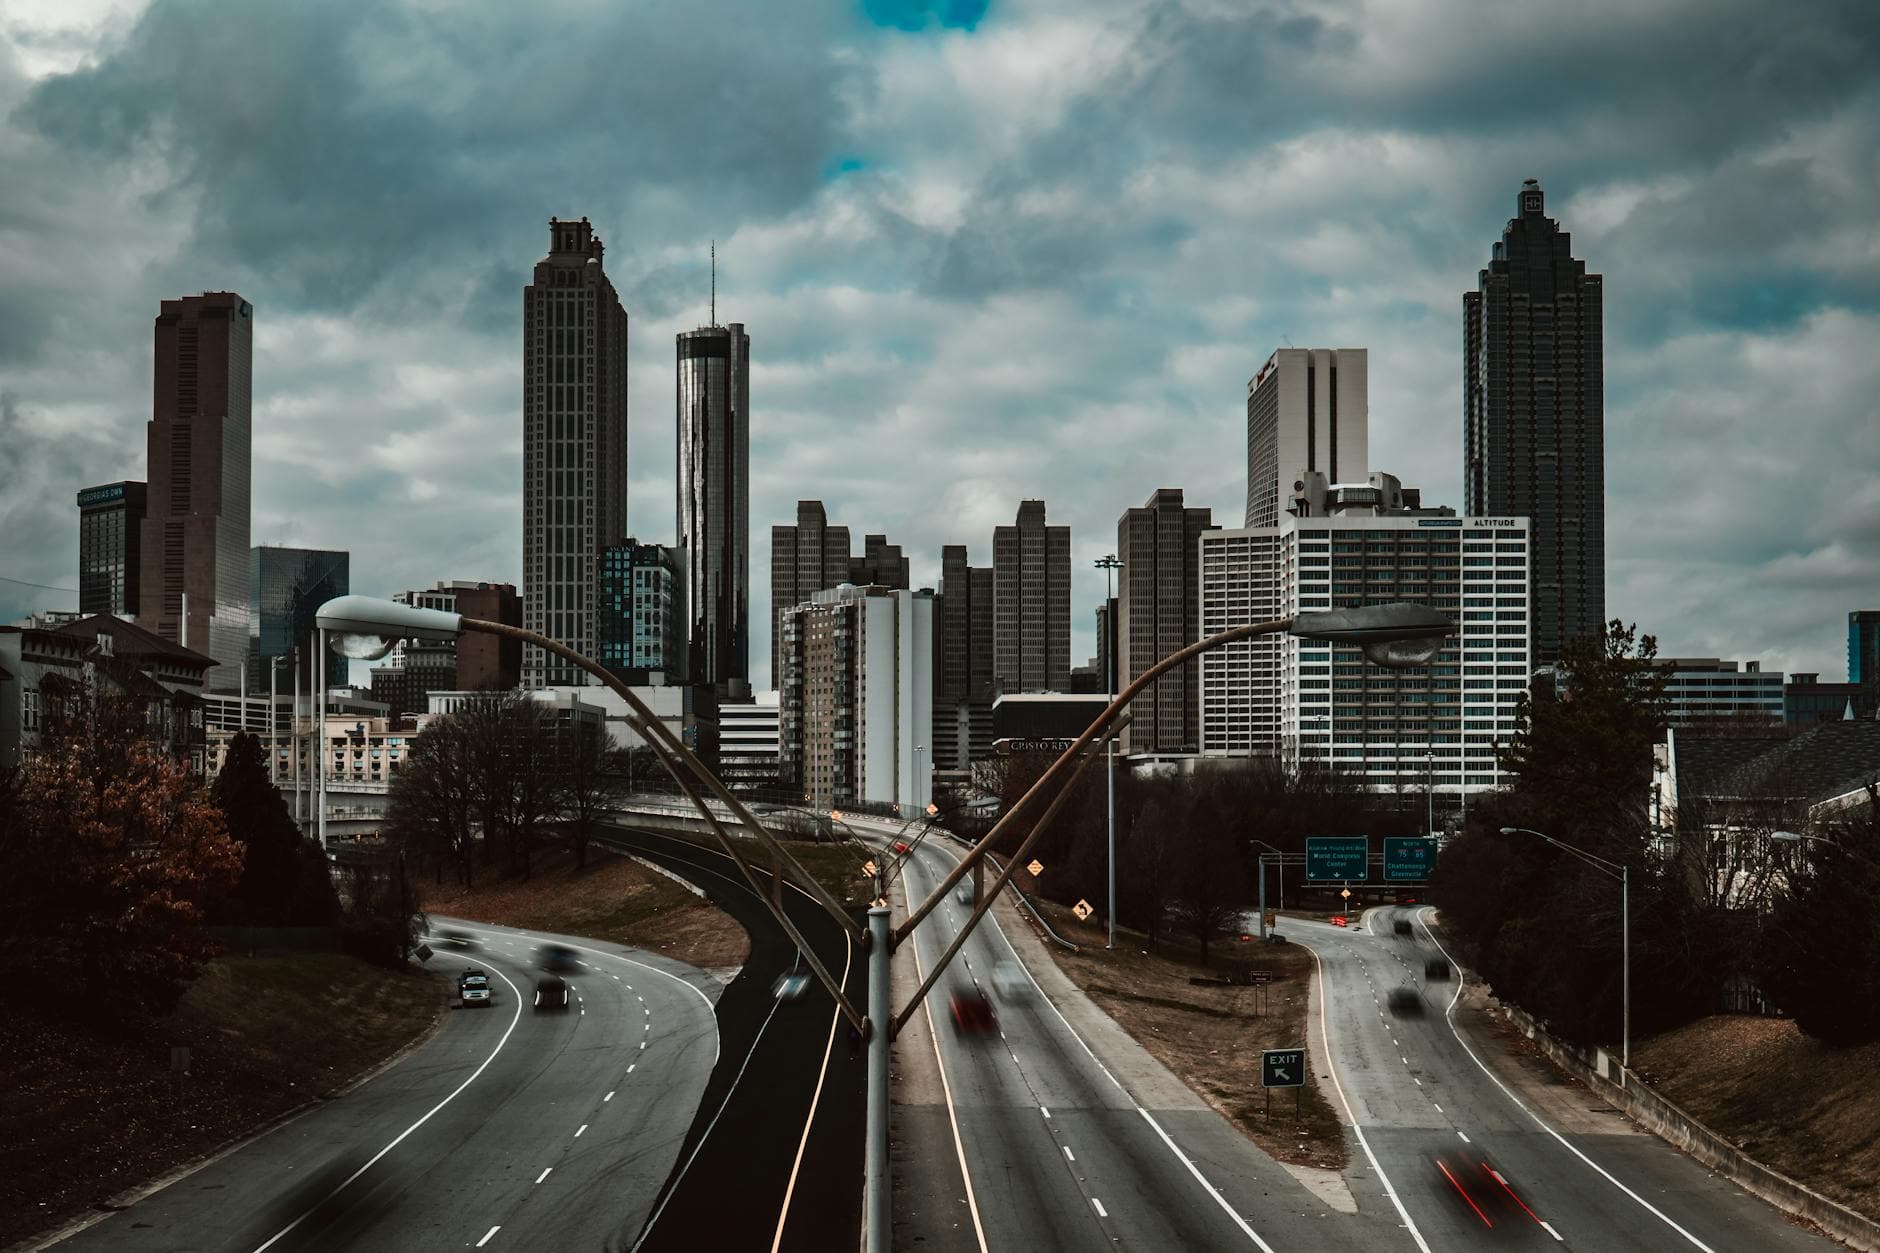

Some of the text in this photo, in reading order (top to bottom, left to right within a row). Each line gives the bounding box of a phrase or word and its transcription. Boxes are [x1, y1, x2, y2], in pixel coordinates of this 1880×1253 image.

[1474, 519, 1515, 527] ALTITUDE
[1010, 741, 1072, 751] CRISTO REY
[1332, 852, 1361, 860] Congress
[1269, 1054, 1298, 1065] EXIT
